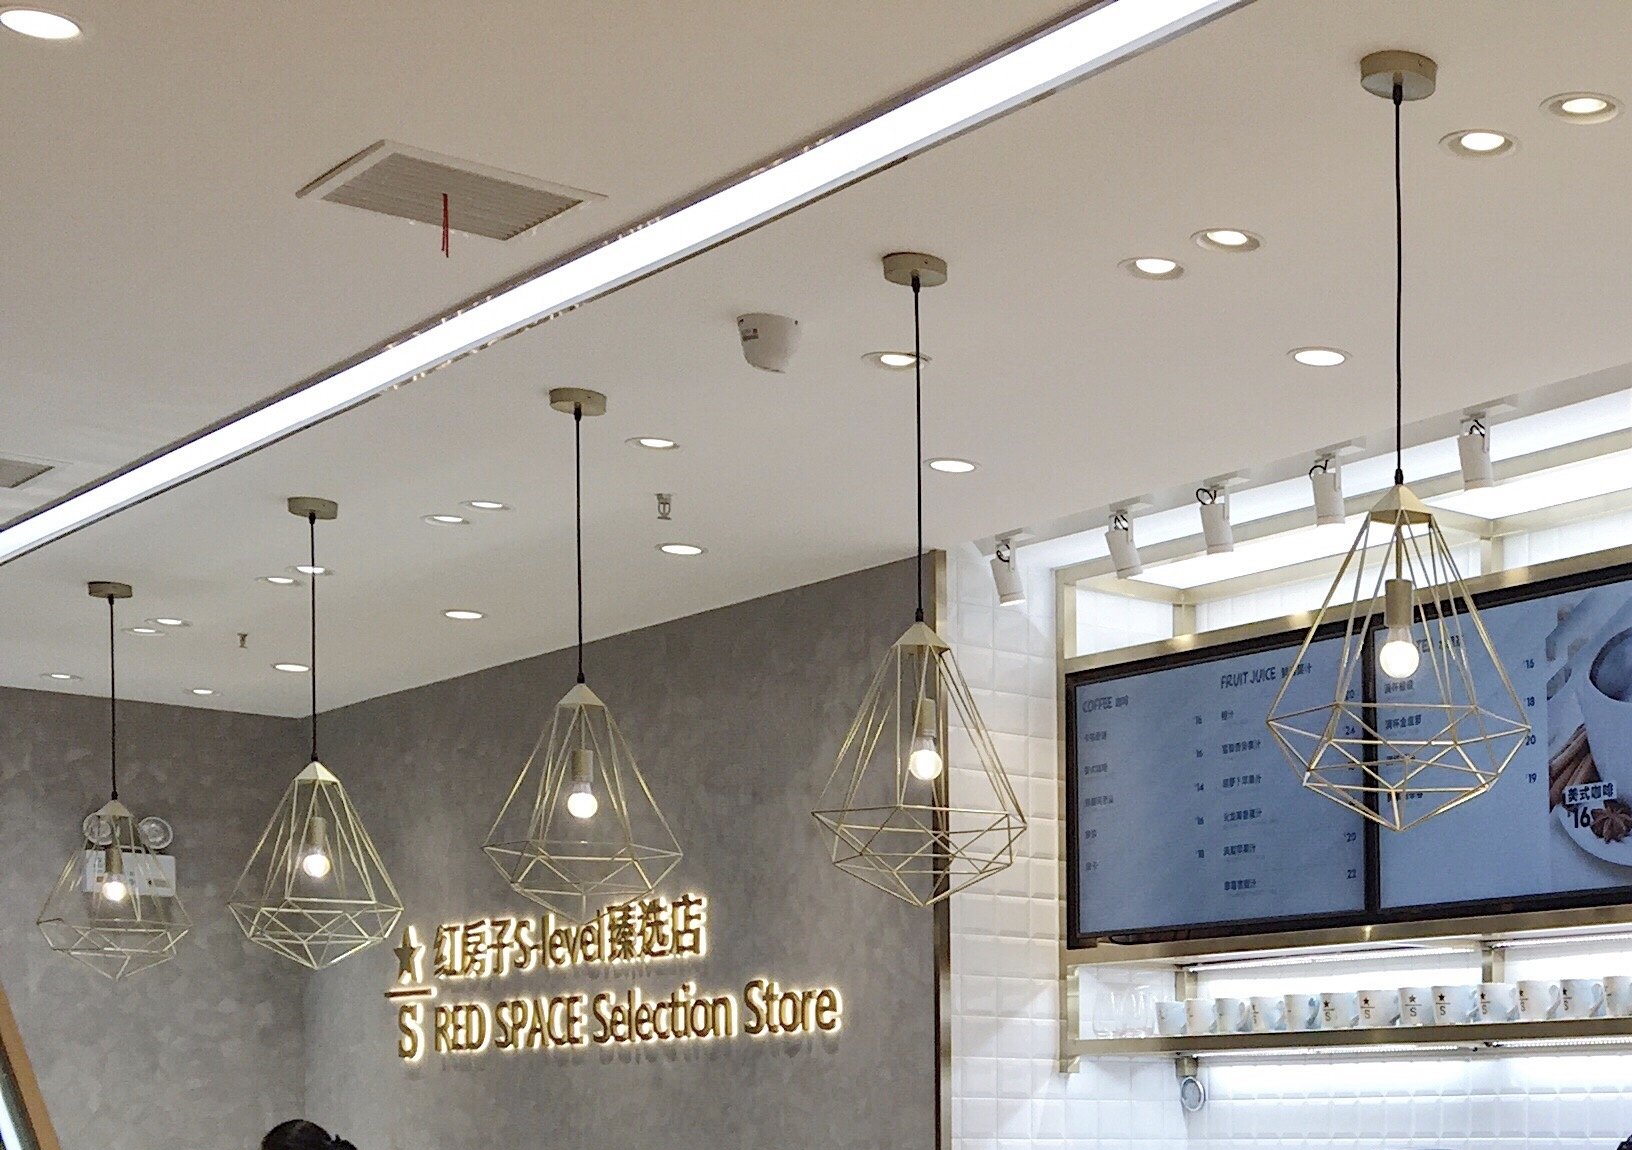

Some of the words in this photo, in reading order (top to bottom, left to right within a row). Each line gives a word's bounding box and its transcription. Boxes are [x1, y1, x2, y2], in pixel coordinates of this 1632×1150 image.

[1220, 671, 1248, 689] FRUIT
[1250, 667, 1276, 684] JUICE
[398, 1003, 421, 1061] S
[434, 1003, 487, 1053] RED
[495, 995, 585, 1050] SPACE
[593, 983, 733, 1045] Selection
[742, 978, 841, 1037] Store
